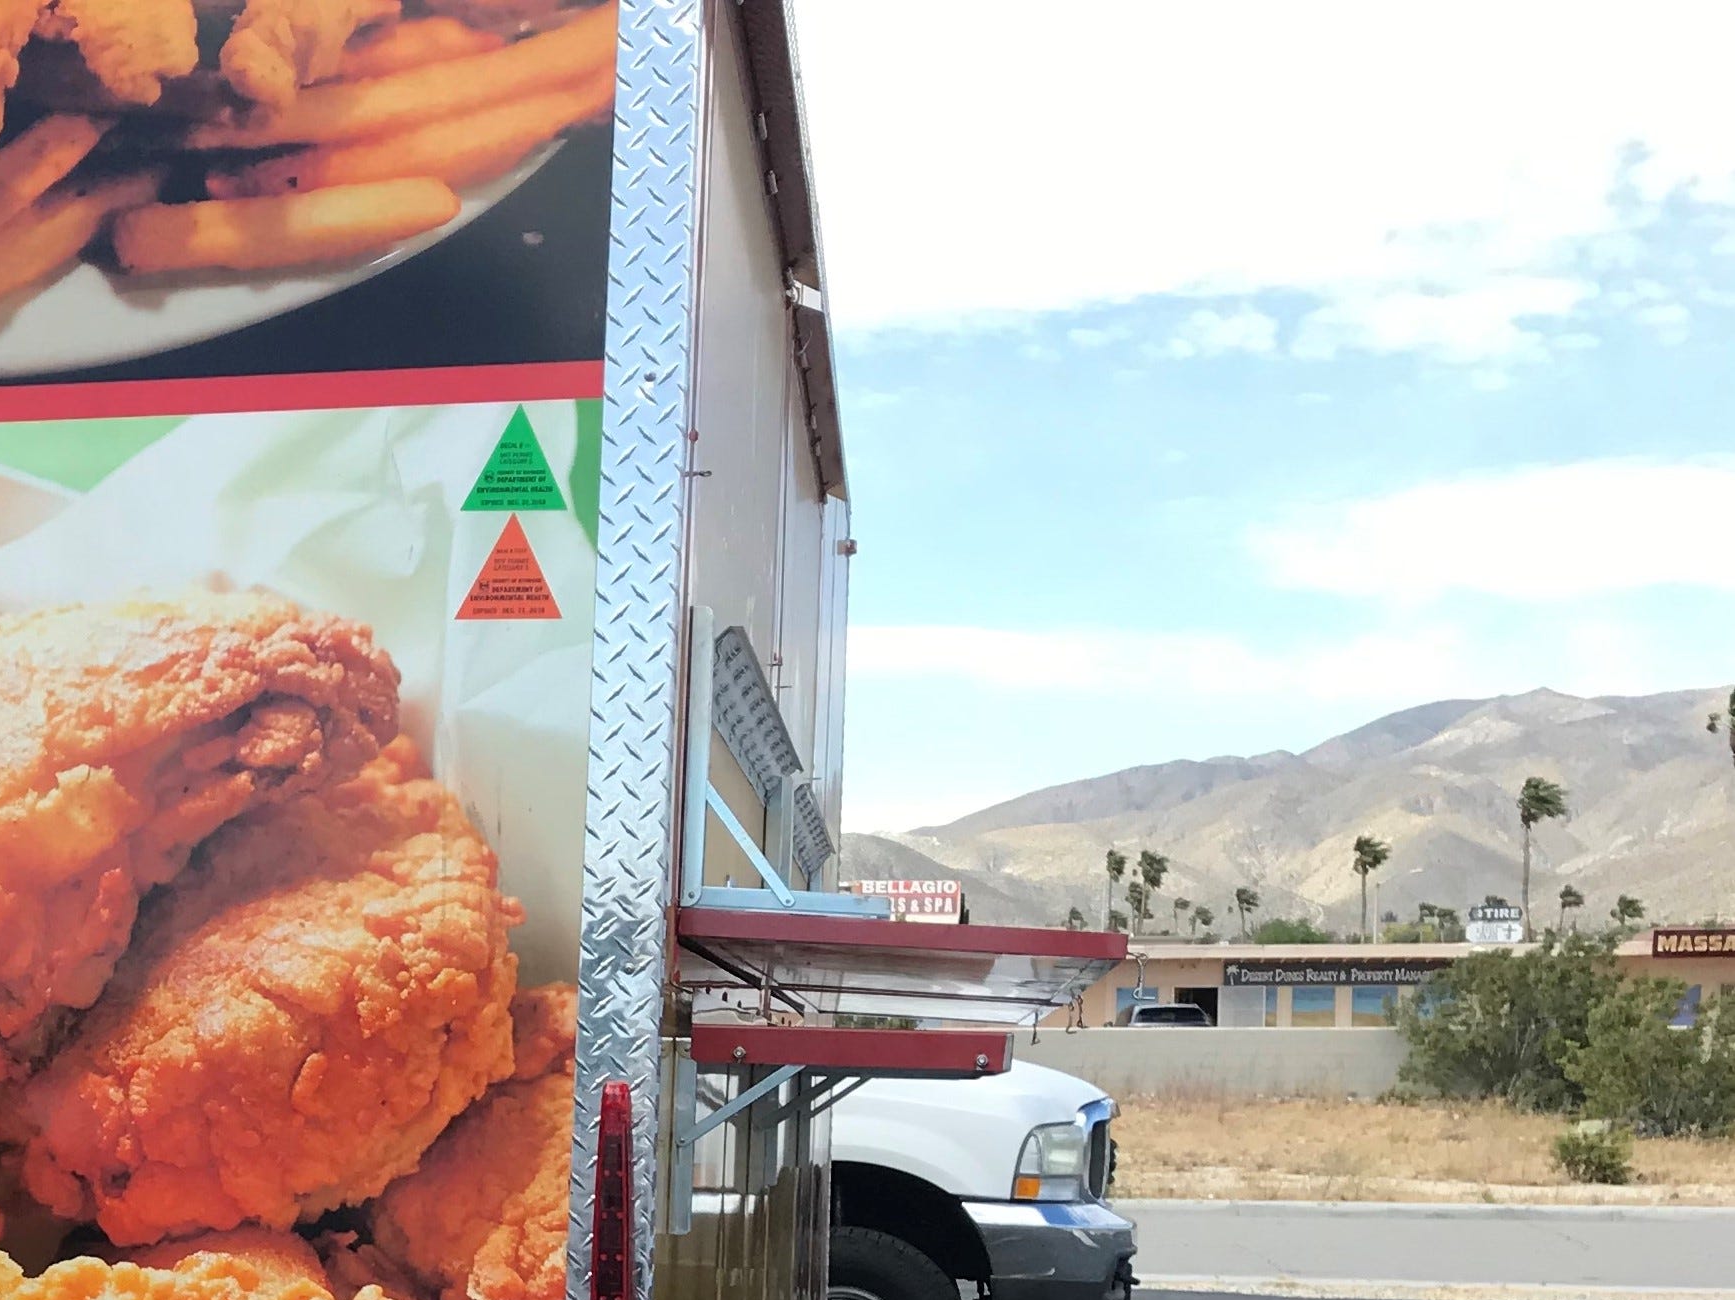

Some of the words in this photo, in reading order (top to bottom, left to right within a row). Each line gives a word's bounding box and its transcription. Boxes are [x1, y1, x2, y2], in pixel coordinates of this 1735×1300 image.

[861, 880, 958, 894] BELLAGIO
[910, 899, 920, 913] &
[924, 897, 953, 913] SPA
